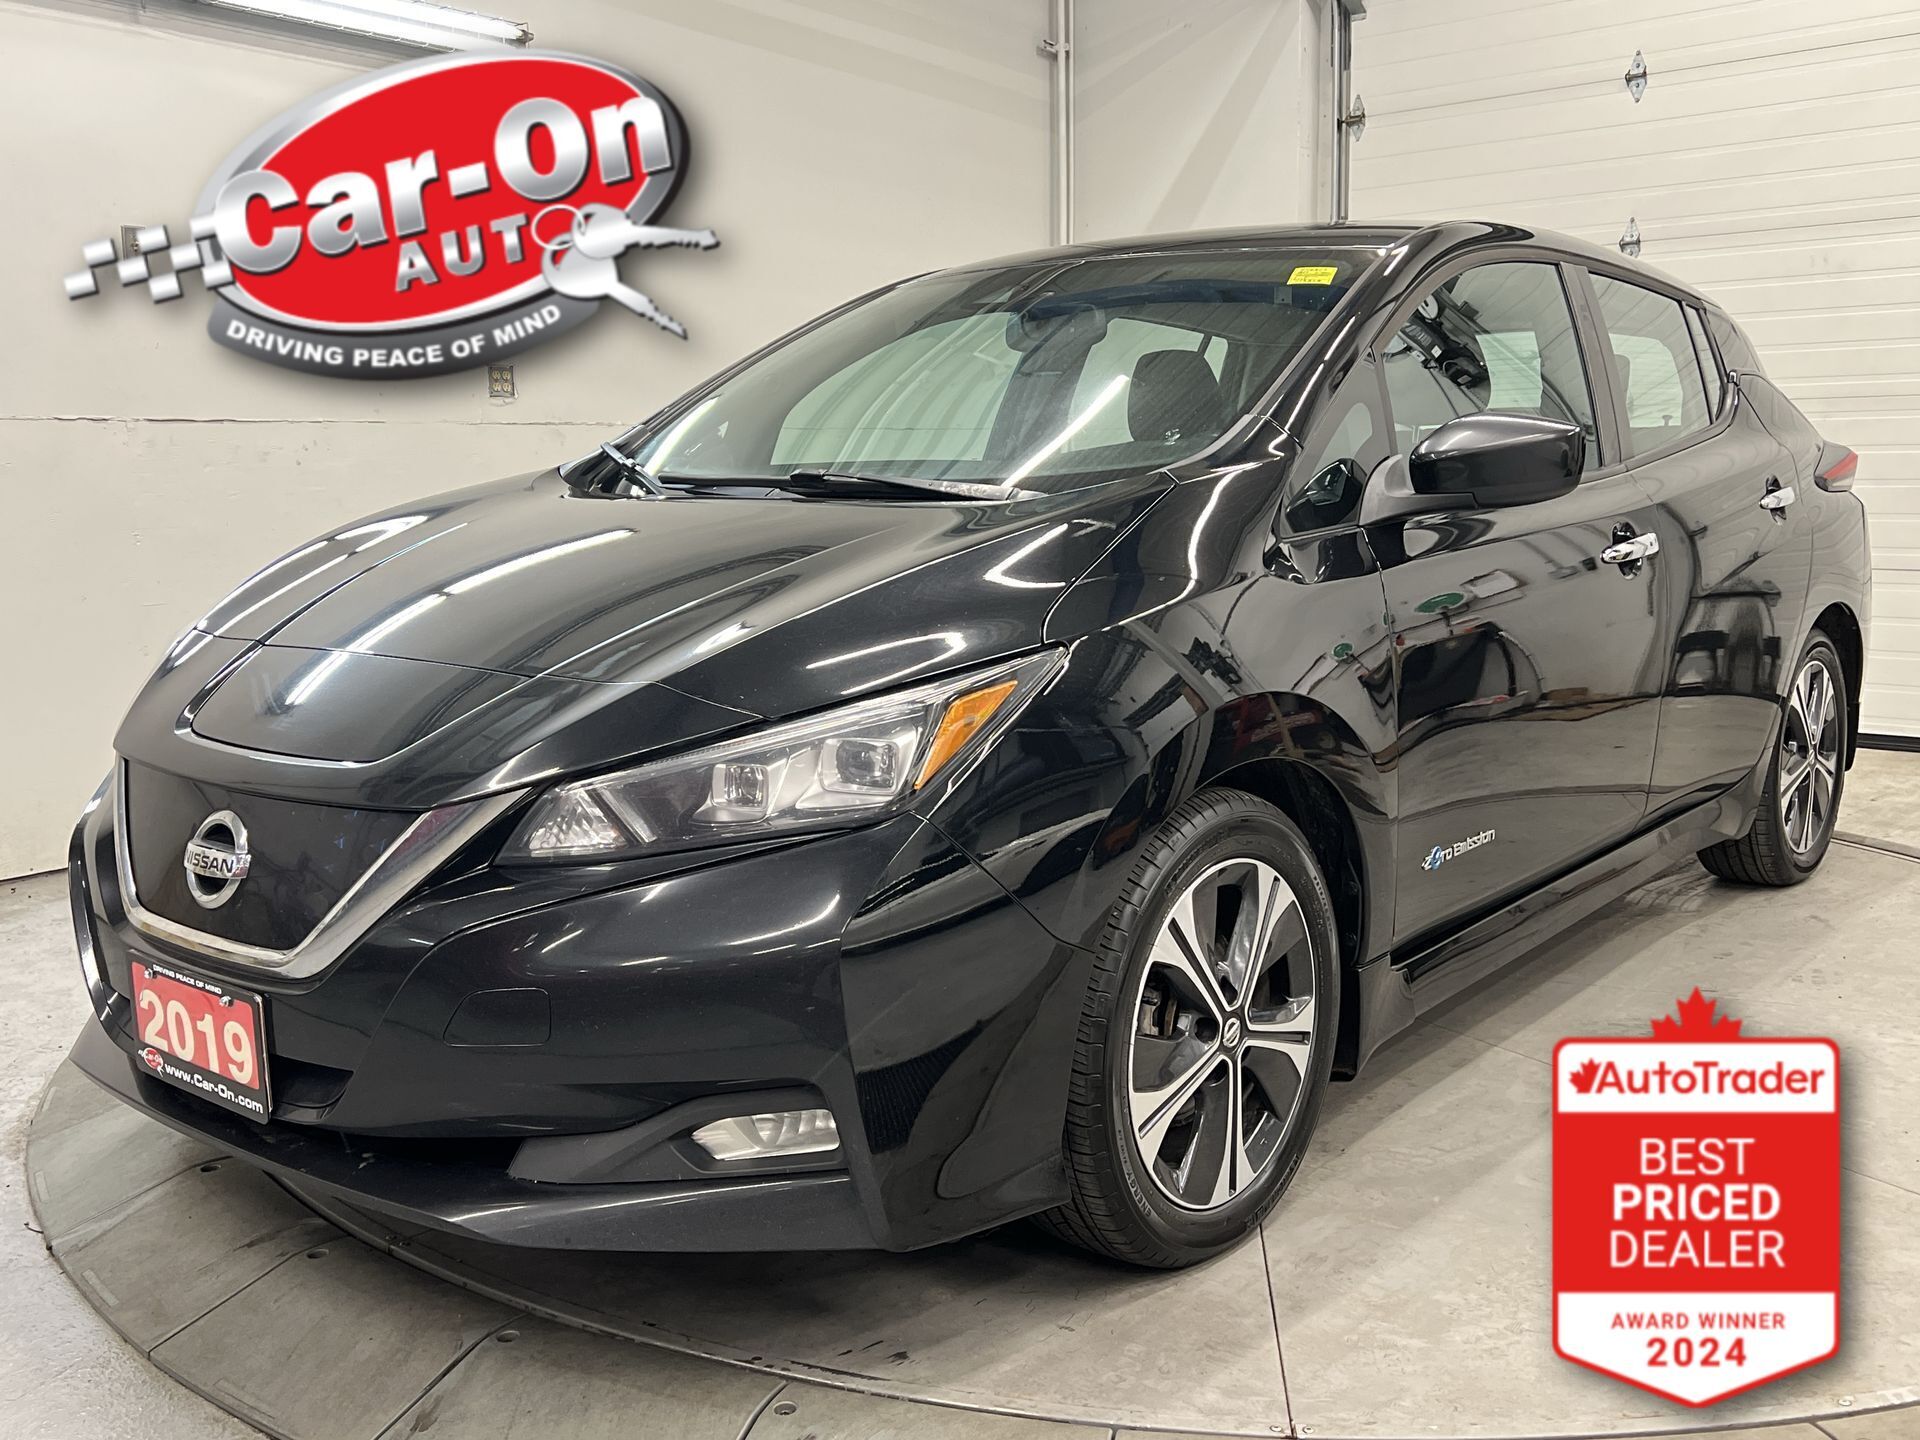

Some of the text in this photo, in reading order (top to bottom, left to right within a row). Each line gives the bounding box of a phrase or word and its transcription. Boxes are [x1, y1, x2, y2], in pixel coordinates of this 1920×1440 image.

[186, 848, 235, 874] NISSAN
[152, 964, 222, 995] DRIVING PEACE OF MIND
[139, 989, 253, 1084] 2019
[165, 1063, 264, 1114] www.Car-On.com
[1126, 1171, 1152, 1217] ENERGY
